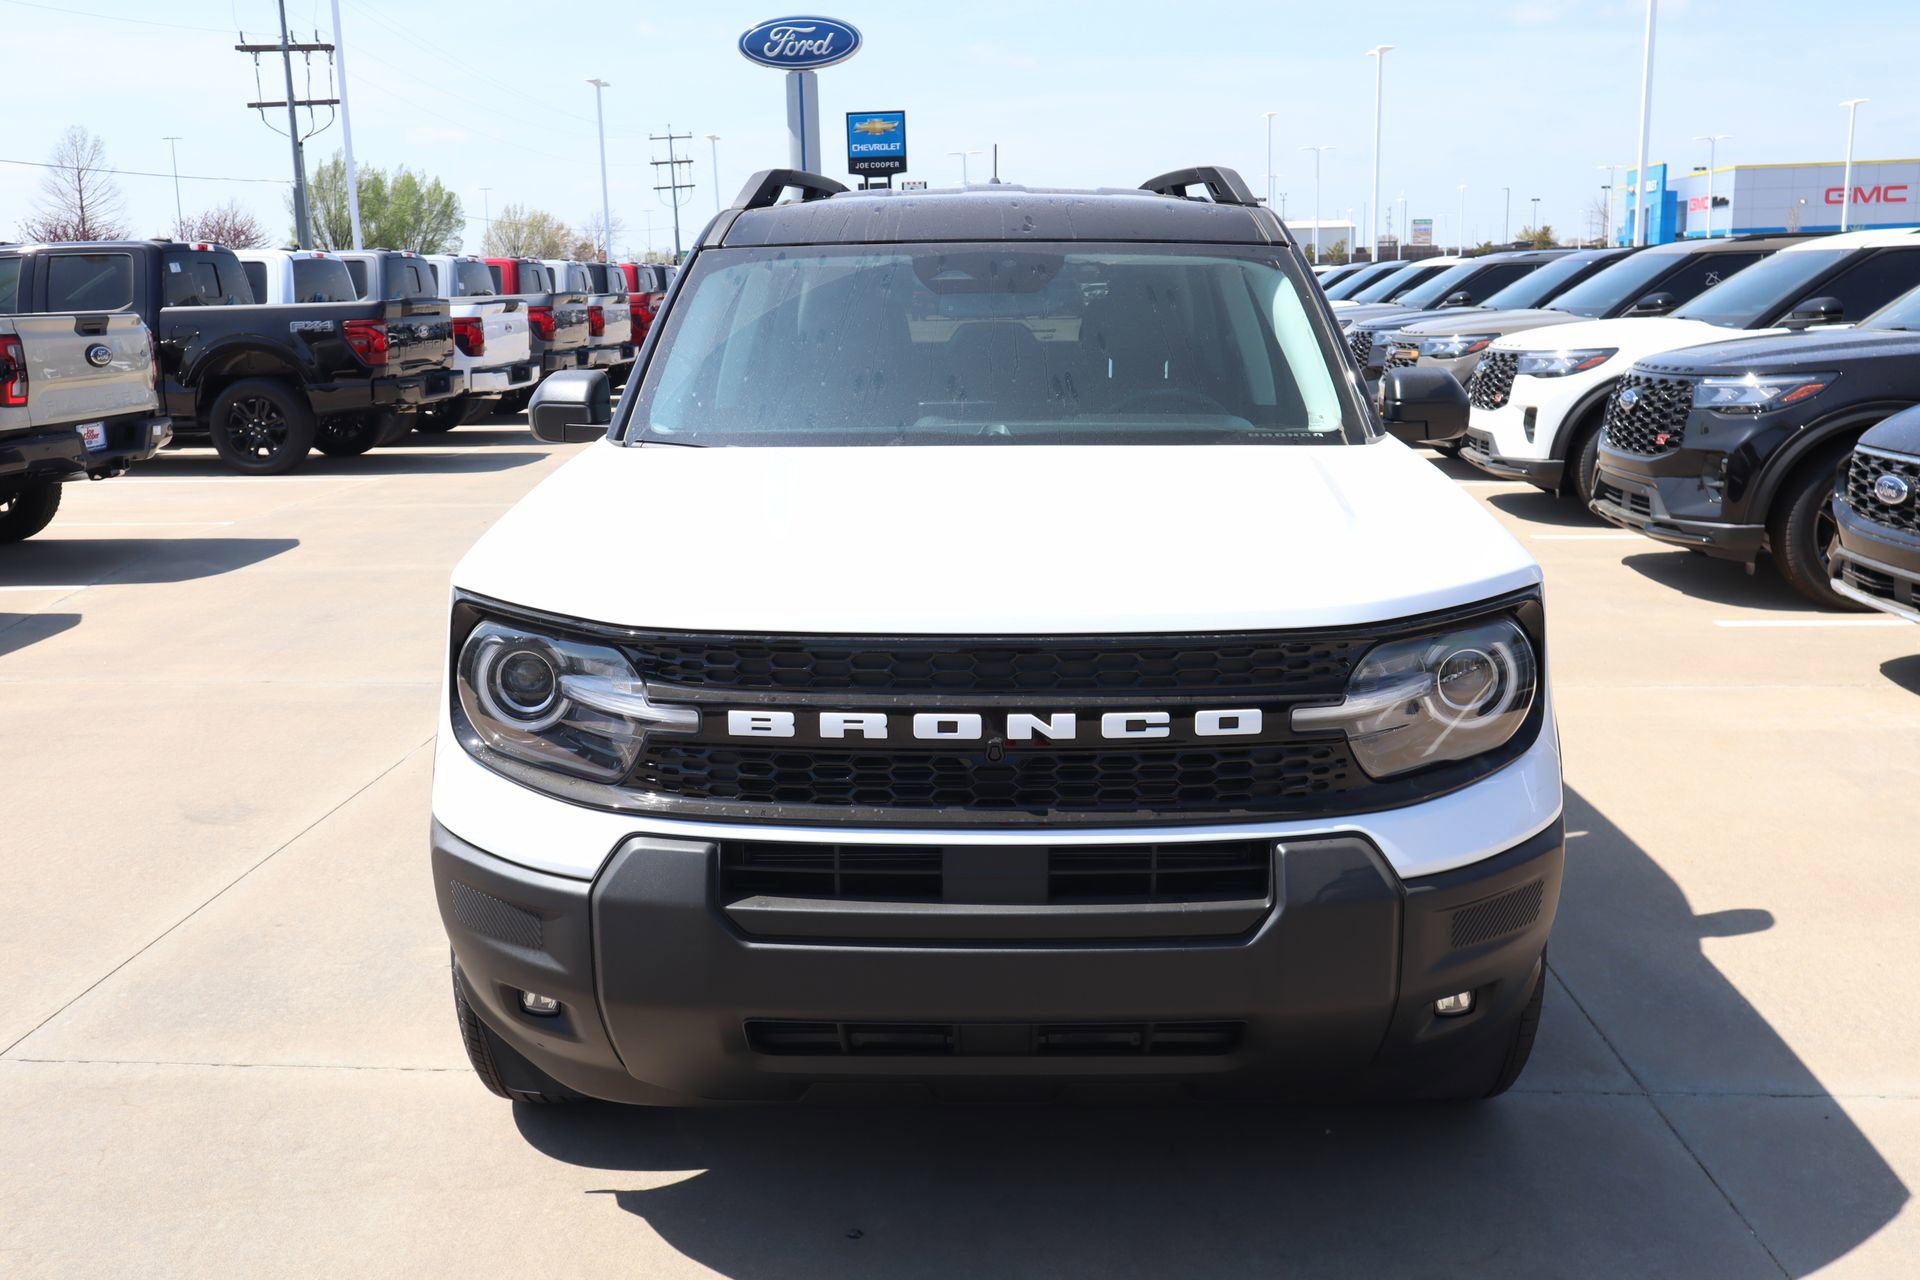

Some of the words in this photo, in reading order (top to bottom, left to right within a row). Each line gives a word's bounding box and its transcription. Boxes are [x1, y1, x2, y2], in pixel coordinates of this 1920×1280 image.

[763, 26, 834, 57] Ford
[851, 142, 902, 152] CHEVROLET
[1824, 184, 1908, 205] GMC
[727, 708, 1263, 740] BRONCO
